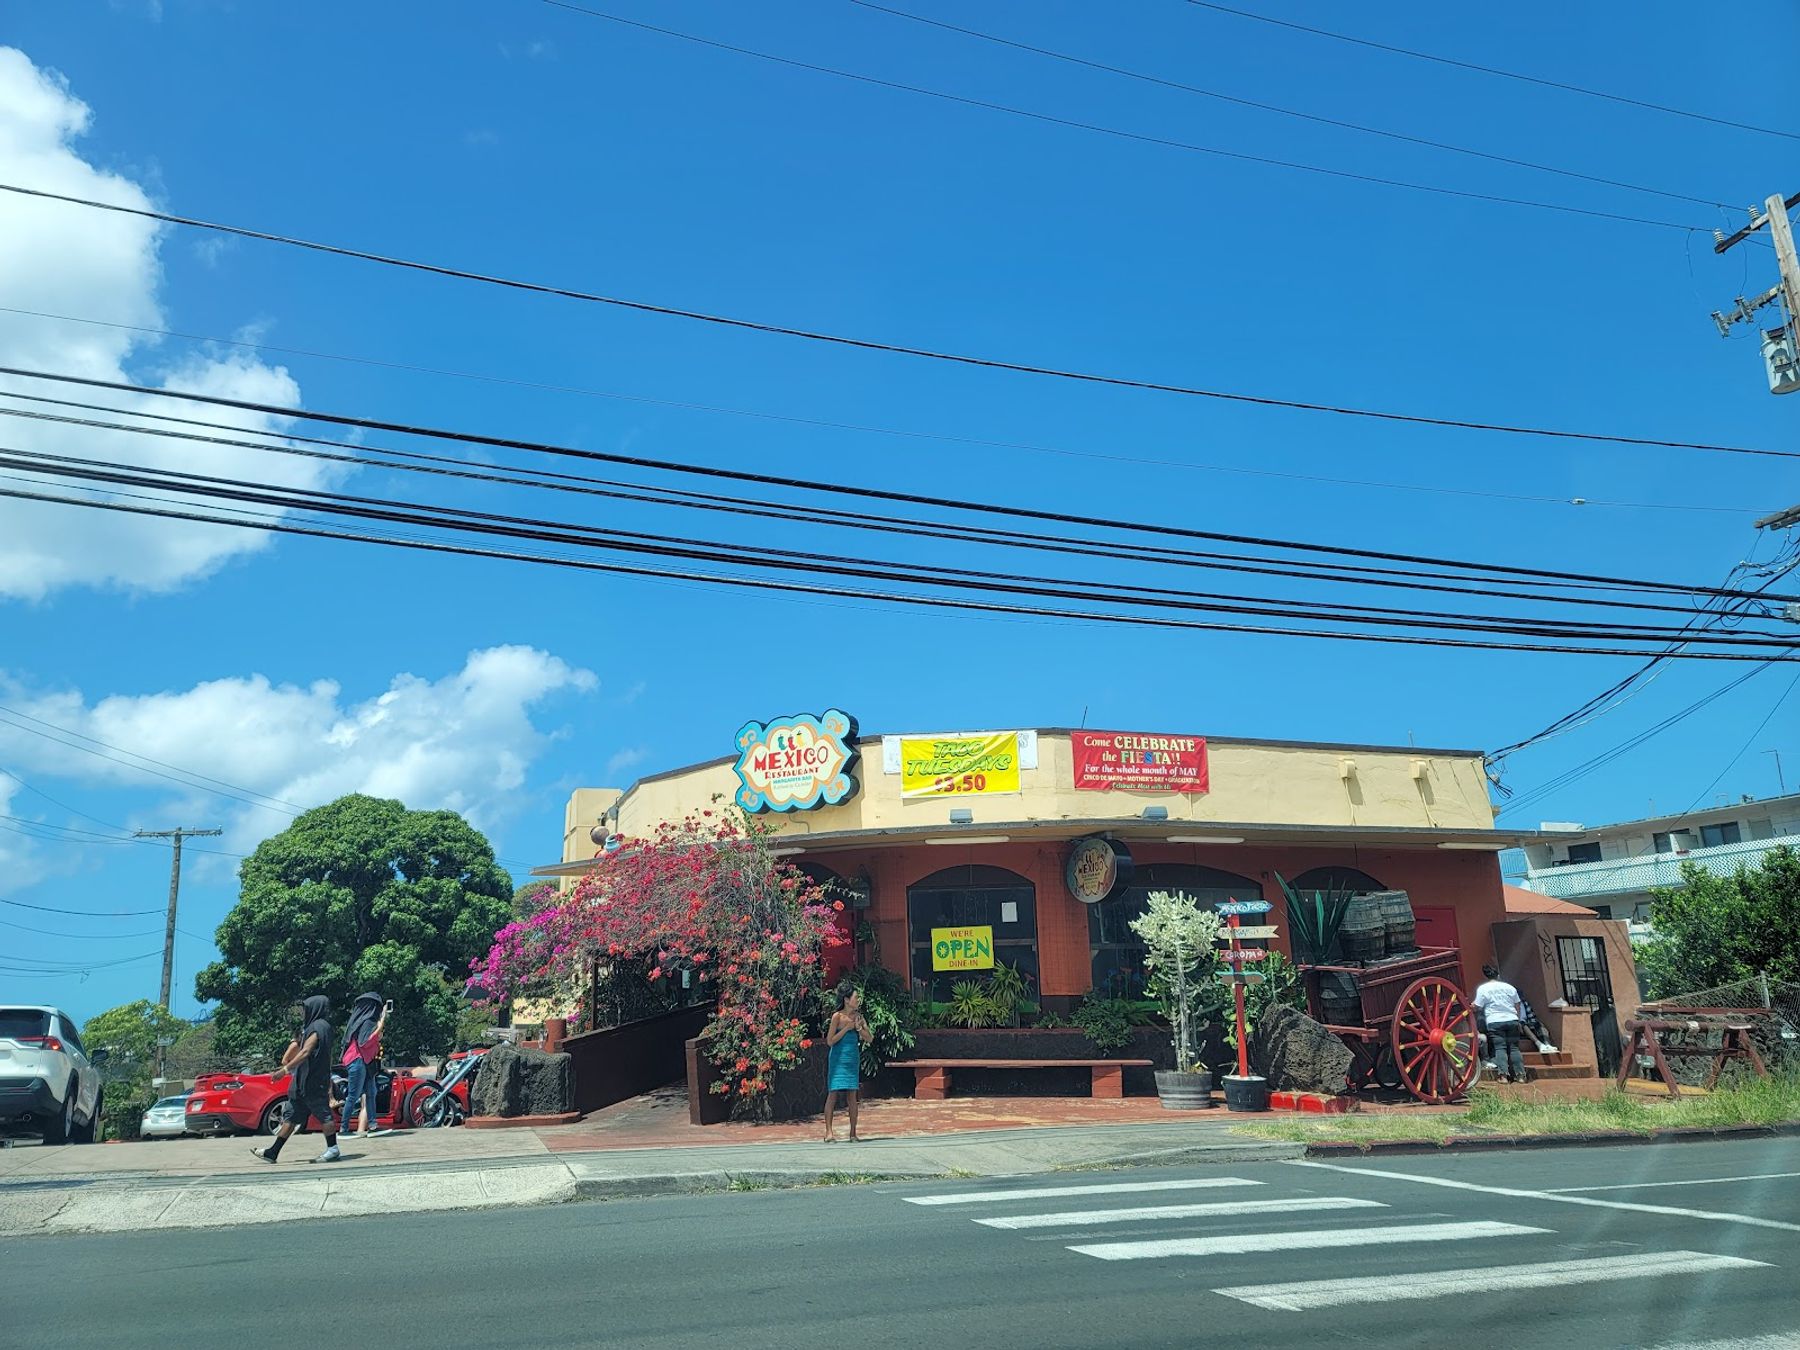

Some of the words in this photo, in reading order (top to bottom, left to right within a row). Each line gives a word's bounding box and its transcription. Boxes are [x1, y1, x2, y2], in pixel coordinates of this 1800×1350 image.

[933, 741, 985, 758] TACO
[1083, 736, 1111, 747] Come
[1114, 736, 1195, 752] CELEBRATE
[754, 745, 829, 772] MEXICO
[907, 754, 1012, 776] TUESDAYS
[1102, 751, 1117, 762] the
[1121, 750, 1181, 765] FIESTA!!
[765, 767, 820, 780] RESTAURANT
[1084, 764, 1099, 773] For
[1102, 764, 1115, 773] the
[1116, 764, 1141, 774] whole
[1142, 766, 1168, 775] month
[1169, 766, 1179, 777] of
[1180, 767, 1198, 776] MAY
[934, 774, 986, 793] $3.50
[936, 936, 990, 960] OPEN
